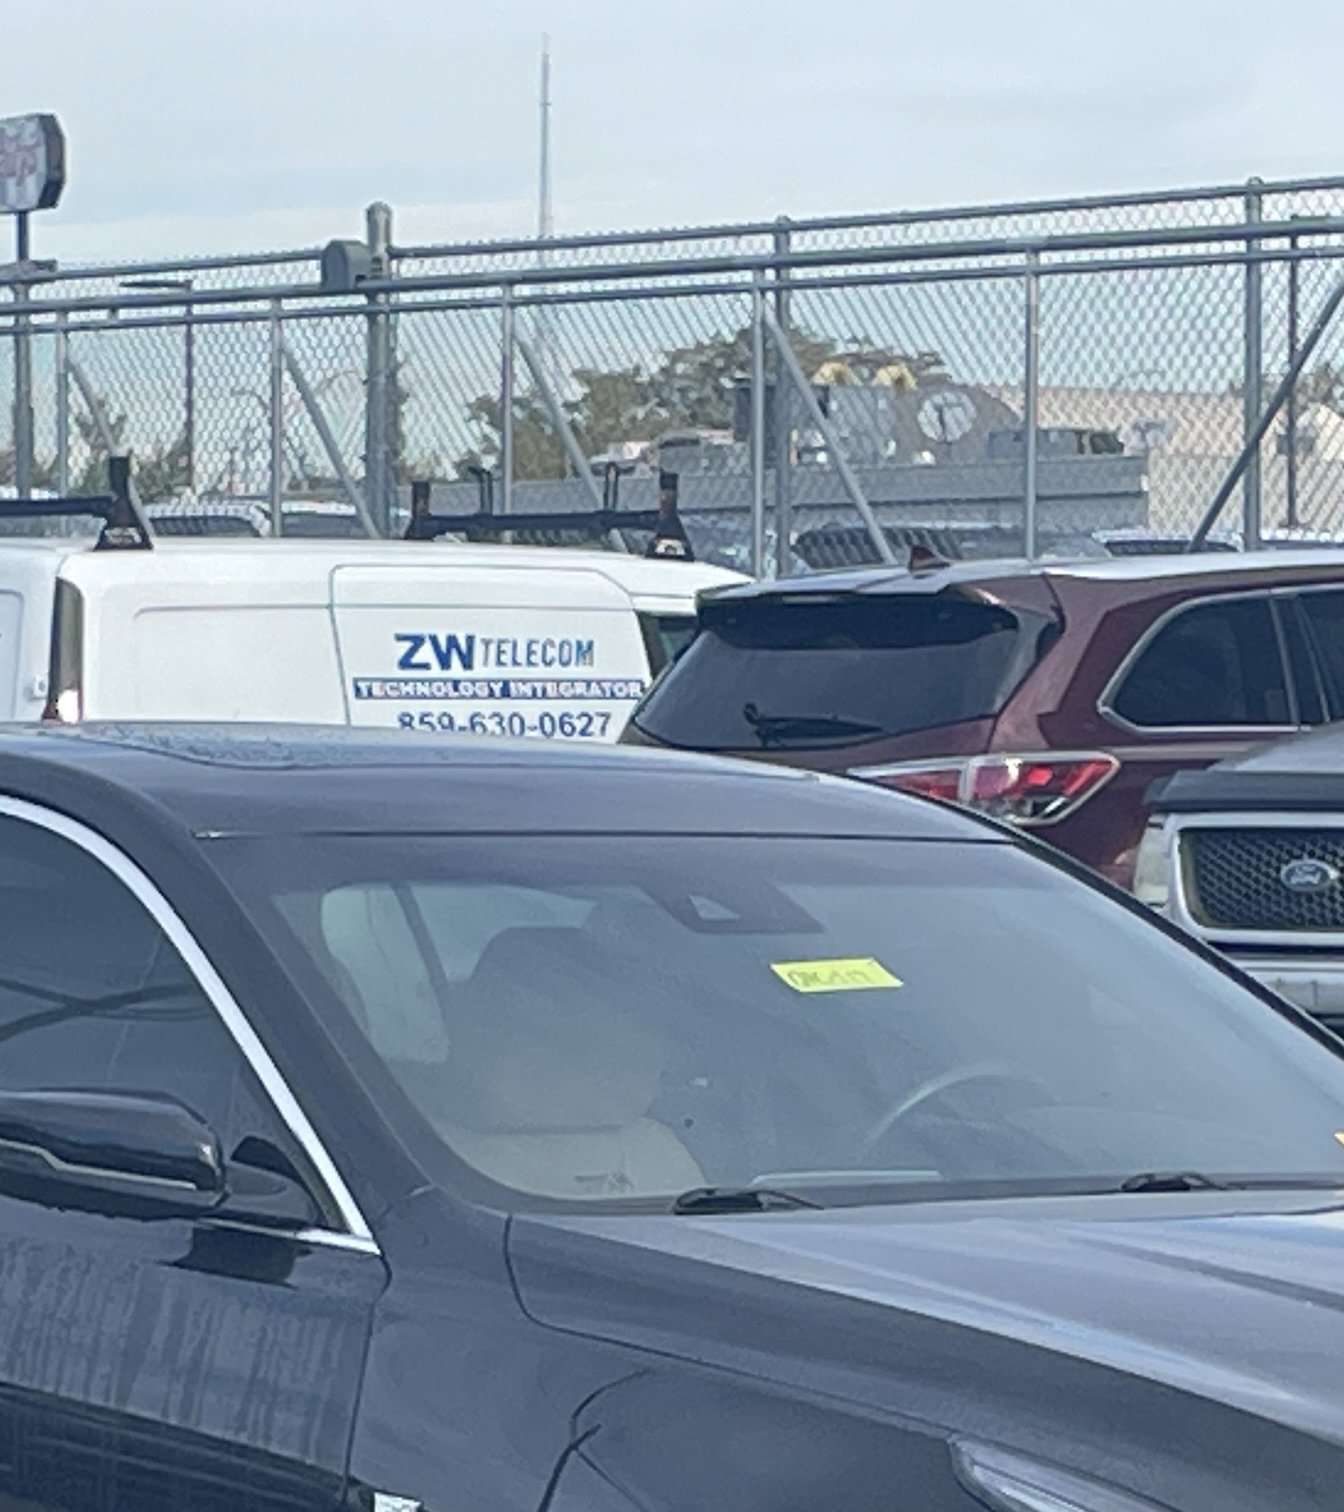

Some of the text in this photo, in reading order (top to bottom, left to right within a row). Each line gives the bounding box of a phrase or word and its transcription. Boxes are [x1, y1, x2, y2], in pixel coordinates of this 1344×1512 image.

[394, 633, 595, 671] ZW TELECOM
[356, 680, 643, 699] TECHNOLOGY INTEGRATOR
[397, 711, 612, 737] 859-630-0627
